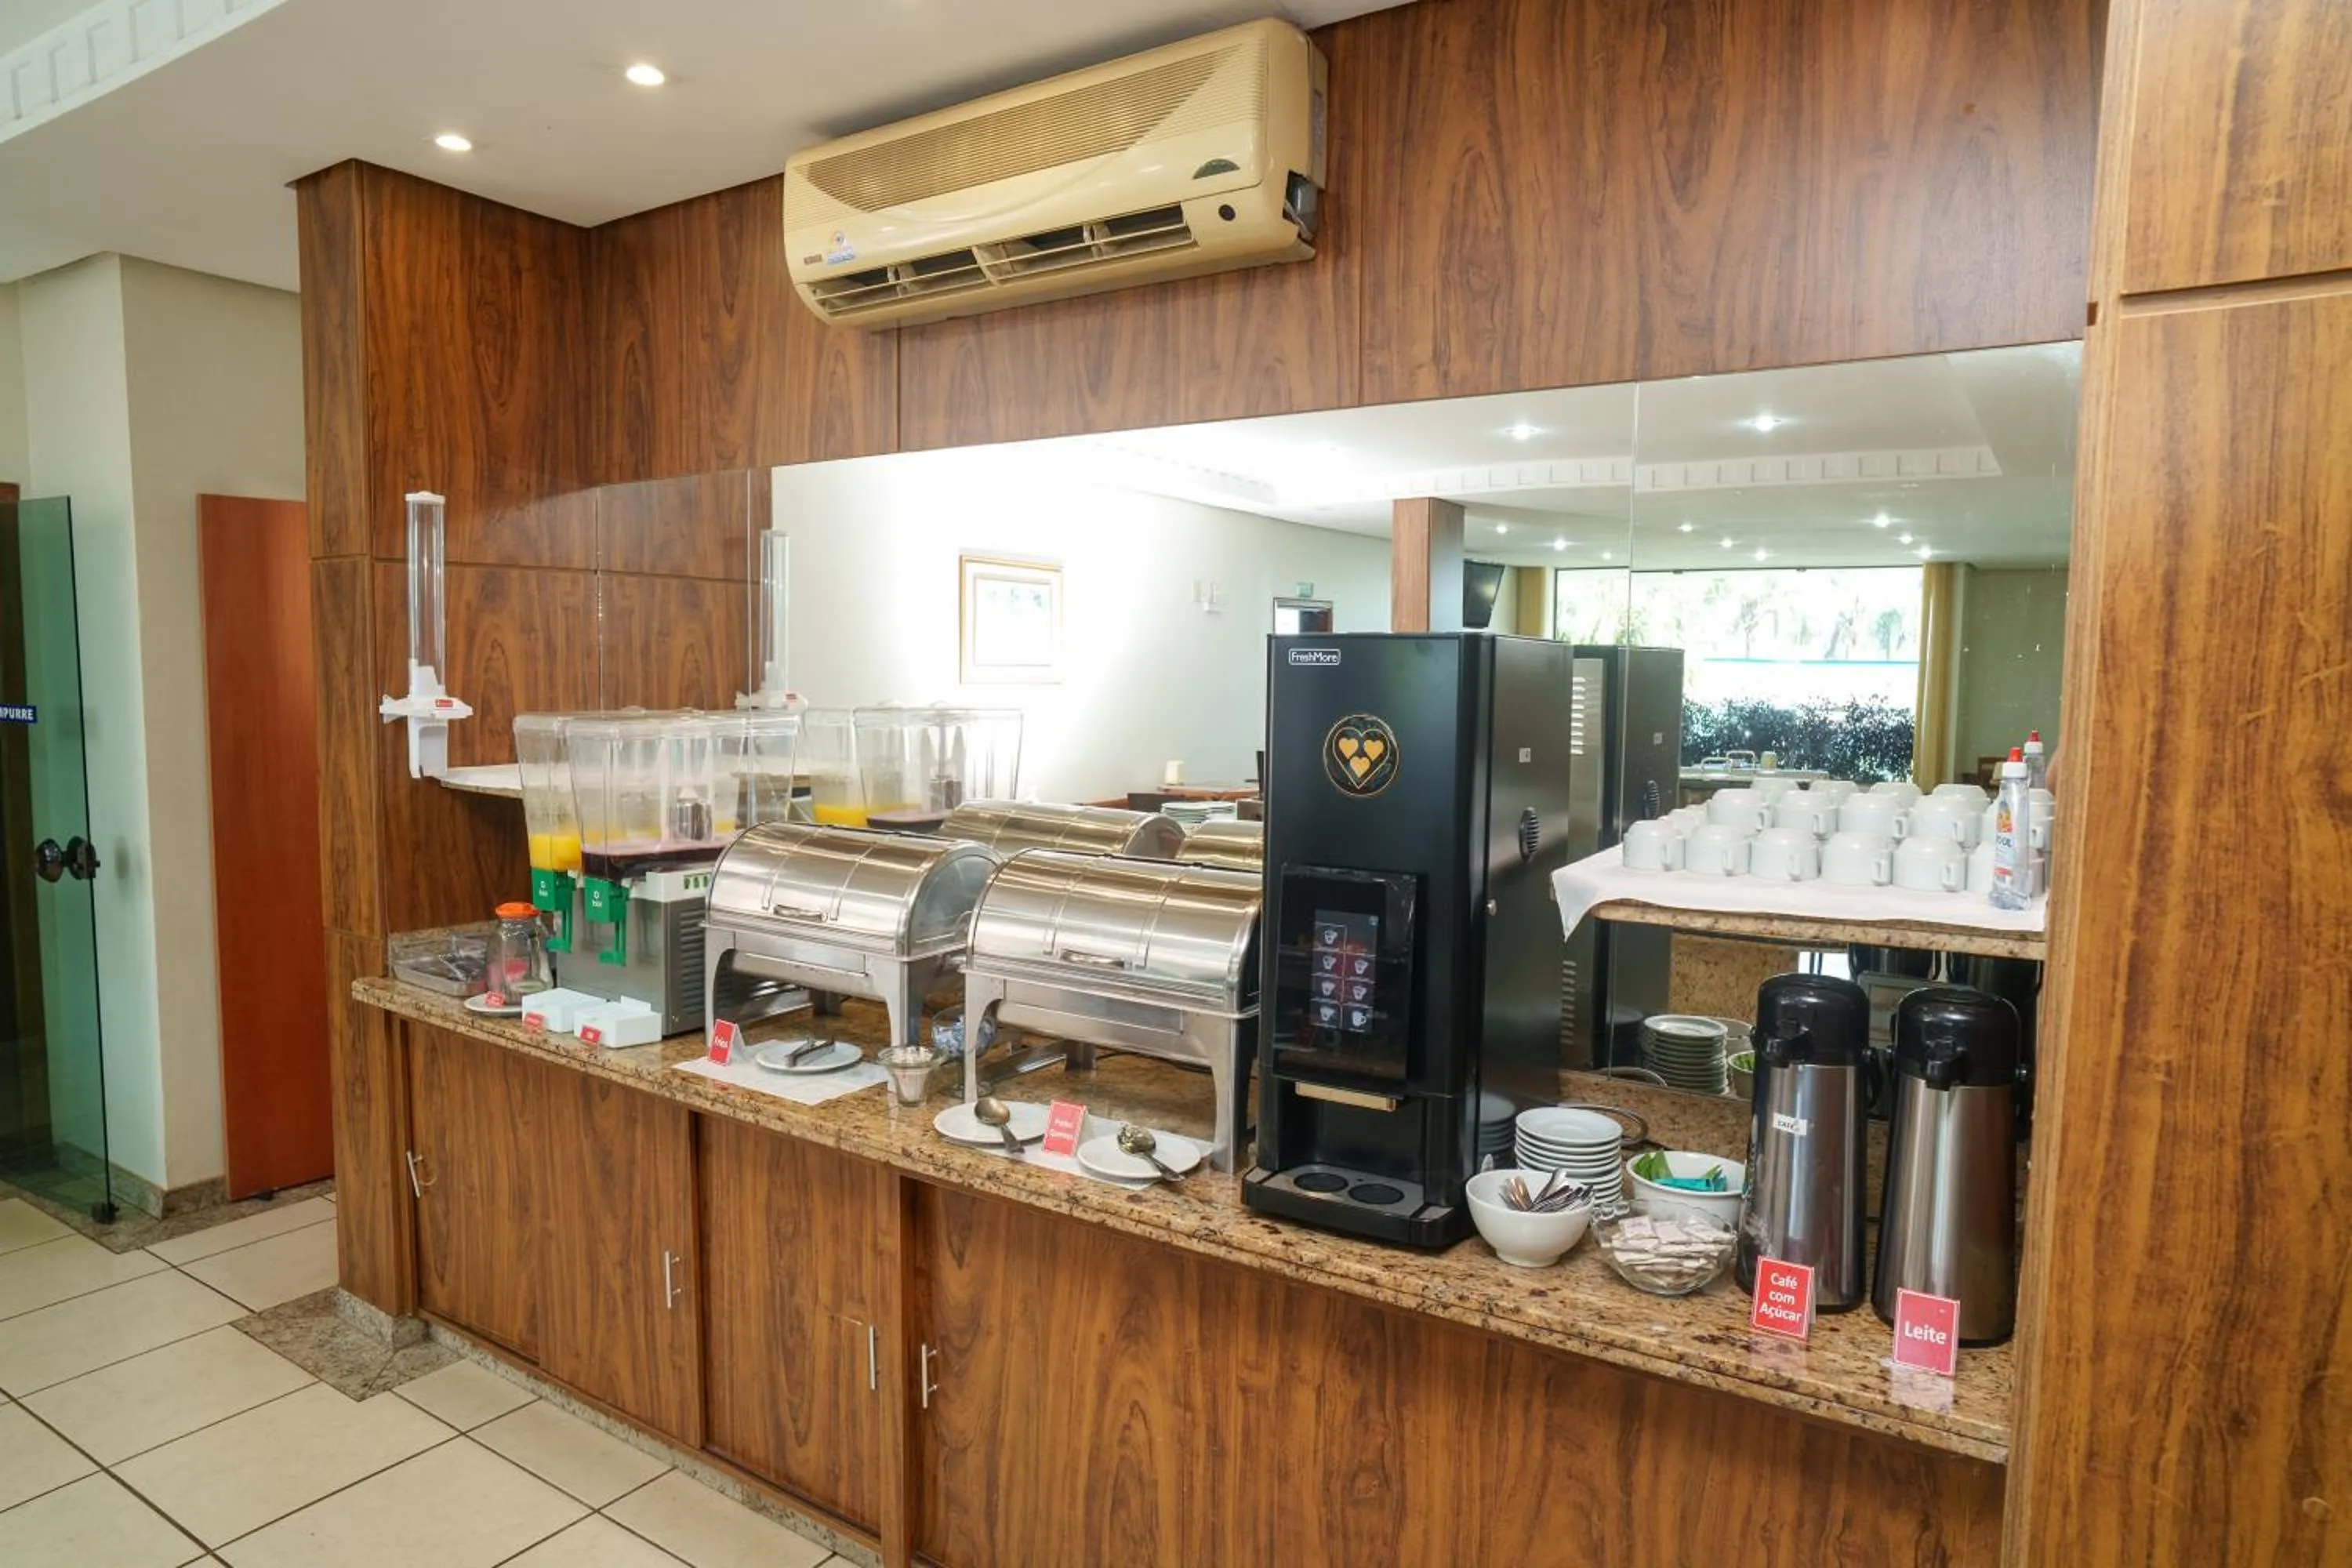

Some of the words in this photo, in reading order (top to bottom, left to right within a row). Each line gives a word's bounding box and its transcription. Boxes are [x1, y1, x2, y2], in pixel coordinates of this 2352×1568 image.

[1291, 652, 1338, 662] FreshMore
[1770, 1272, 1798, 1290] Café
[1769, 1290, 1795, 1305] com
[1759, 1301, 1802, 1323] Açúcar
[1904, 1320, 1947, 1345] Leite
